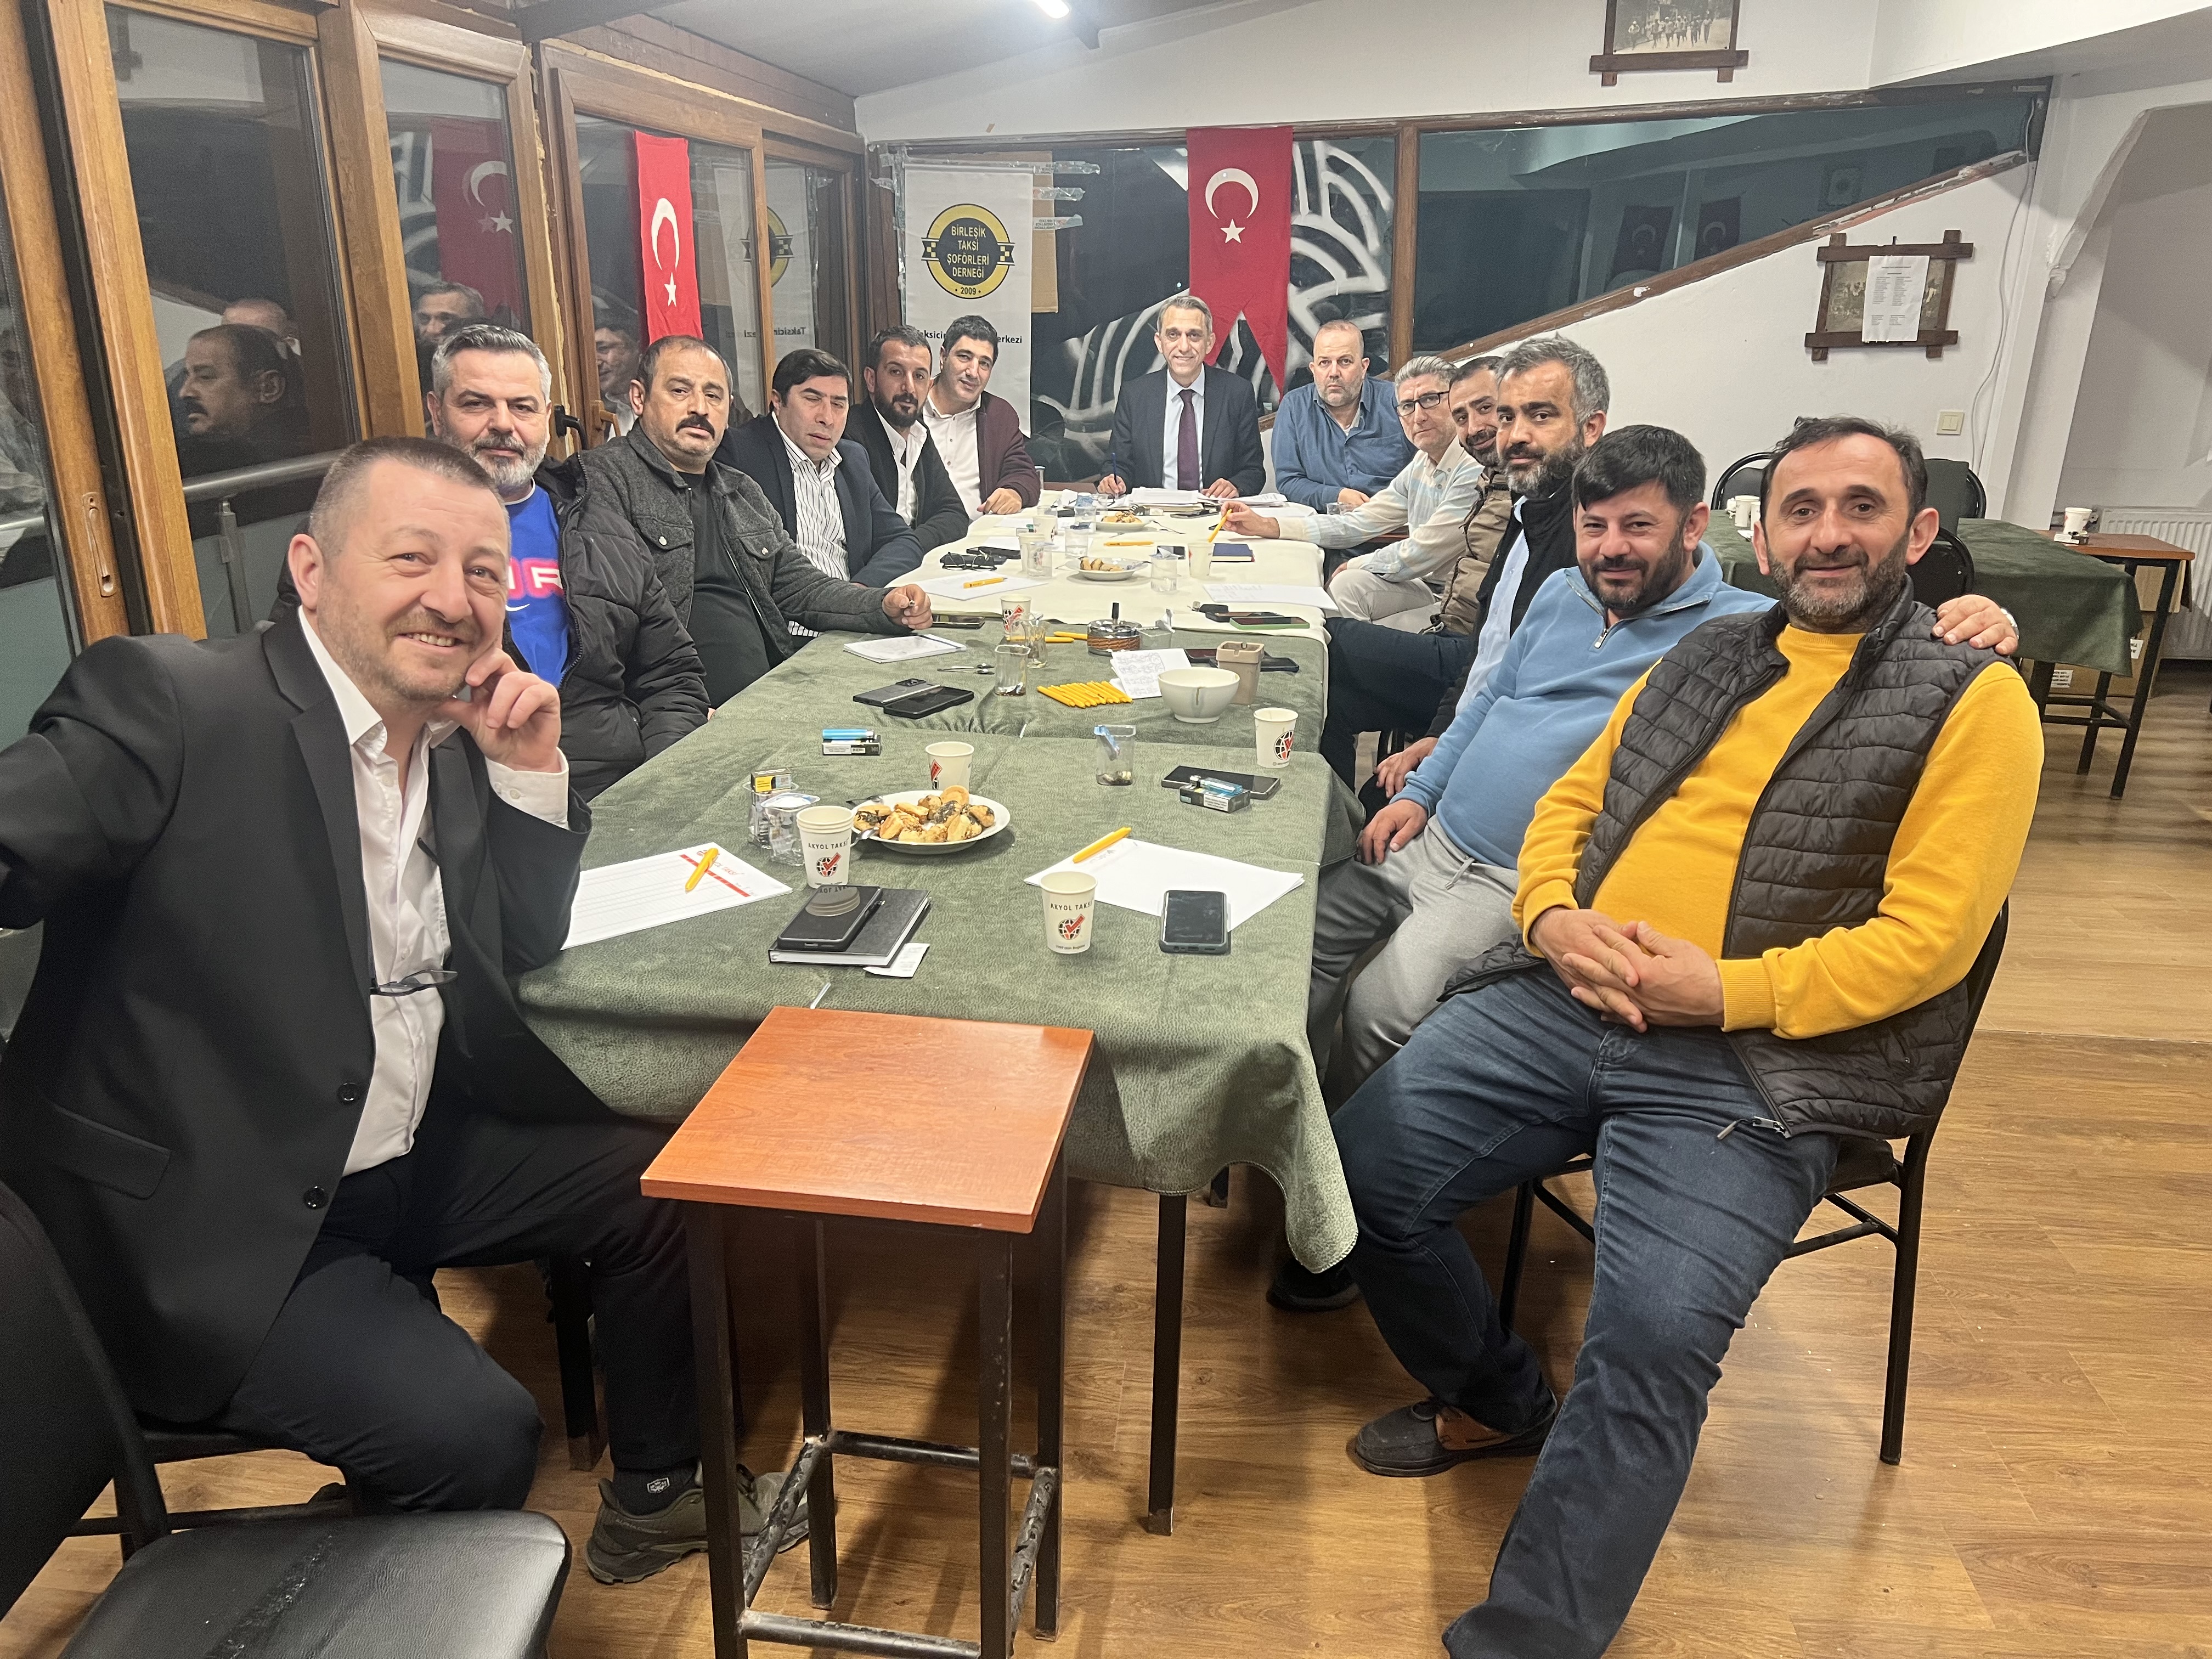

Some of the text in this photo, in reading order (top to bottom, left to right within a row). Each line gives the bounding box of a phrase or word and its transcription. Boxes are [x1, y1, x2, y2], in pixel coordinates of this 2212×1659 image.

[951, 225, 986, 239] BİRLEŞİK
[957, 239, 979, 251] TAKSİ
[947, 253, 990, 266] ŞOFÖRLERİ
[952, 266, 985, 279] DERNEĞİ
[960, 286, 977, 295] 2009
[997, 335, 1023, 343] erkezi
